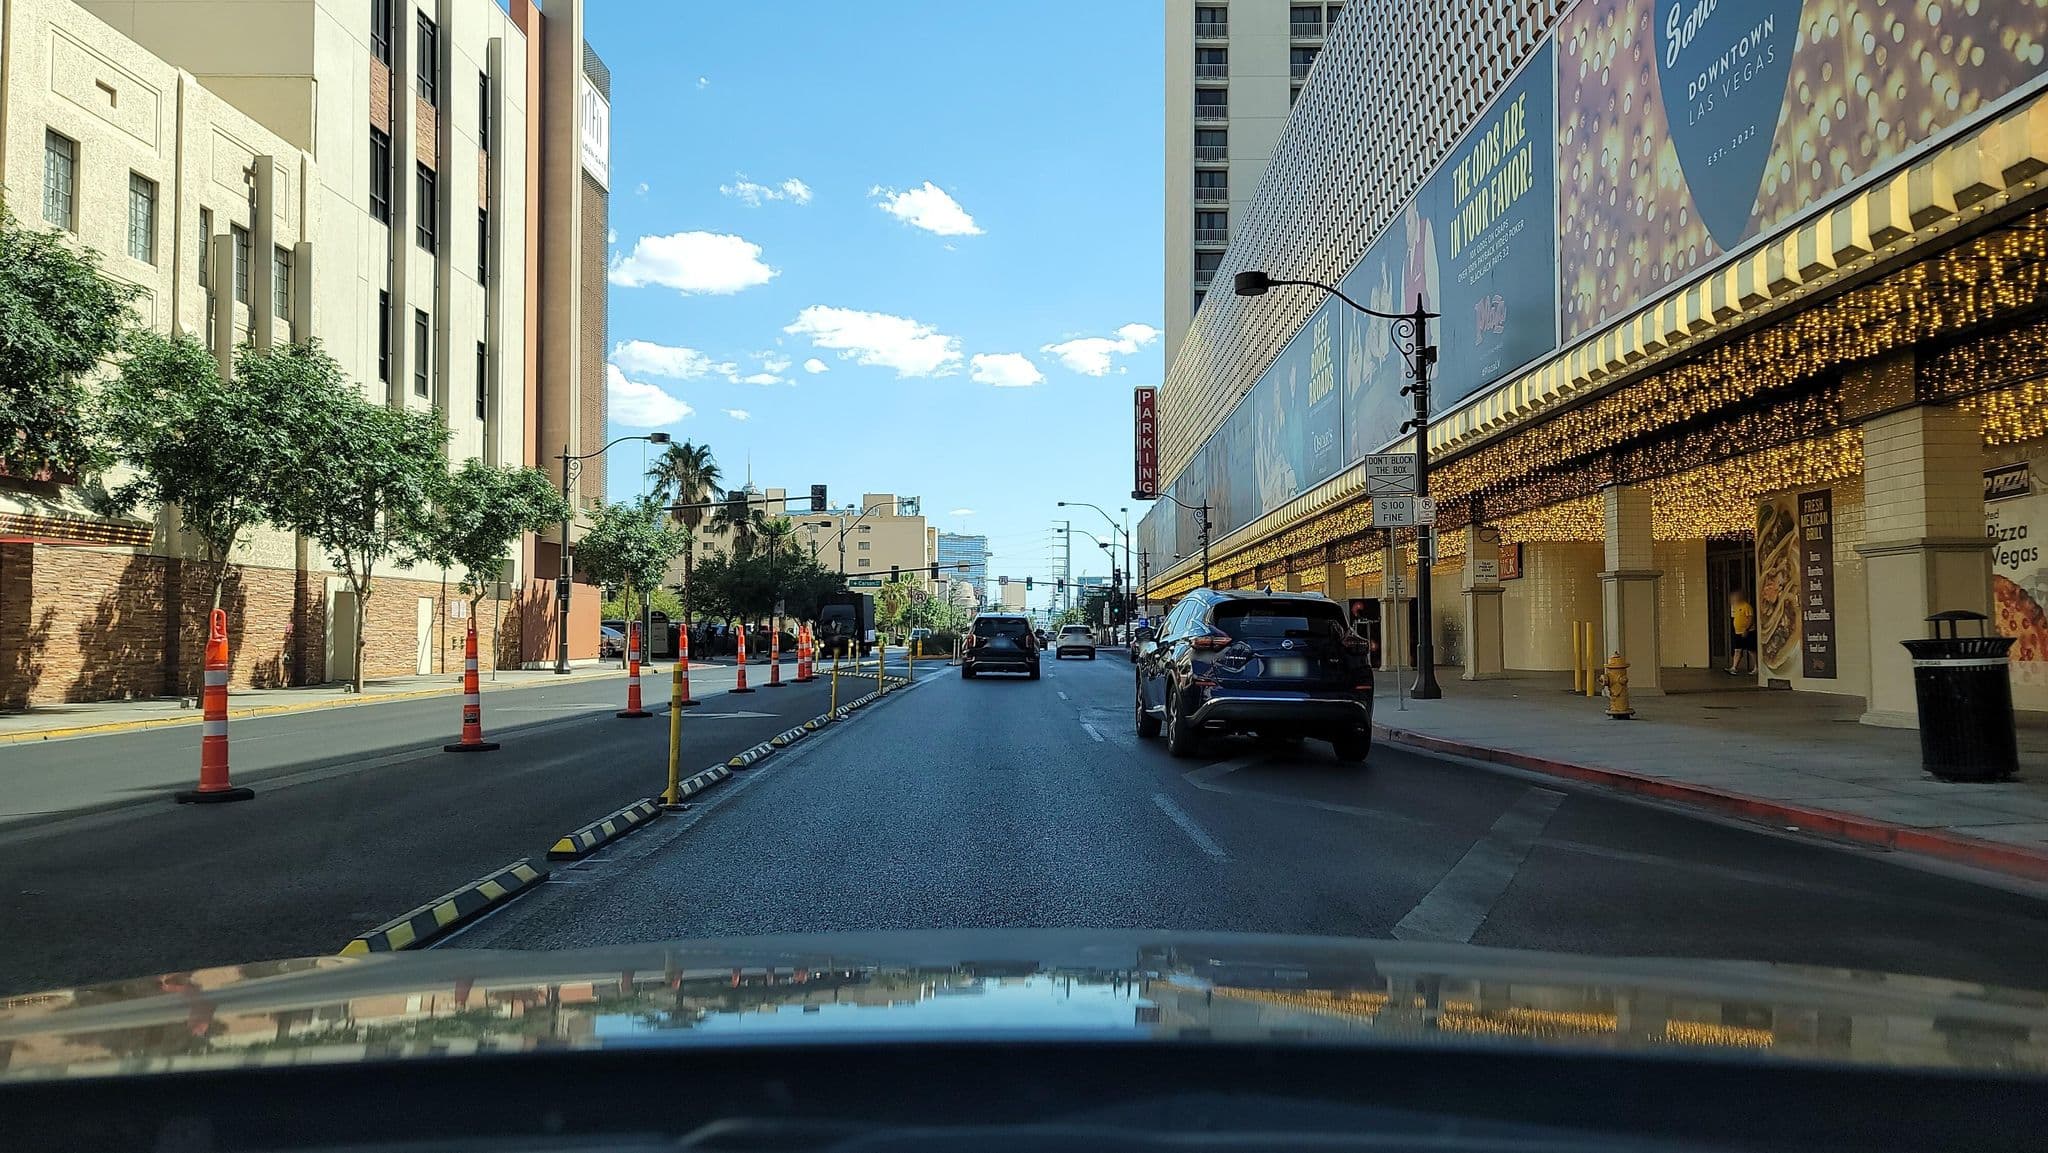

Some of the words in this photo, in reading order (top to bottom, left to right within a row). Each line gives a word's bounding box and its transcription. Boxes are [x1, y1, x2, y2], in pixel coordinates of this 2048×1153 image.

[1688, 14, 1774, 101] DOWNTOWN
[1689, 94, 1714, 126] LAS
[1722, 44, 1775, 98] VEGAS
[1452, 156, 1471, 209] THE
[1472, 121, 1500, 187] ODDS
[1503, 91, 1526, 158] ARE
[1707, 148, 1727, 166] EST.
[1731, 125, 1755, 149] 2022
[1450, 214, 1461, 260] IN
[1462, 187, 1488, 247] YOUR
[1491, 140, 1533, 222] FAVOR!
[1313, 310, 1329, 350] BEEF
[1310, 336, 1331, 379] BOOZE
[1308, 362, 1334, 408] BROADS
[1142, 391, 1153, 493] PARKING
[1368, 457, 1388, 465] DON'T
[1391, 455, 1413, 464] BLOCK
[1376, 466, 1389, 474] THE
[1393, 465, 1407, 474] BOX
[1992, 469, 2029, 494] PIZZA
[1383, 513, 1403, 522] FINE
[1800, 511, 1828, 528] MEXICAN
[1804, 497, 1824, 513] FRESH
[1805, 526, 1823, 541] GRILL
[1987, 523, 2028, 542] Pizza
[1992, 545, 2038, 571] Vegas
